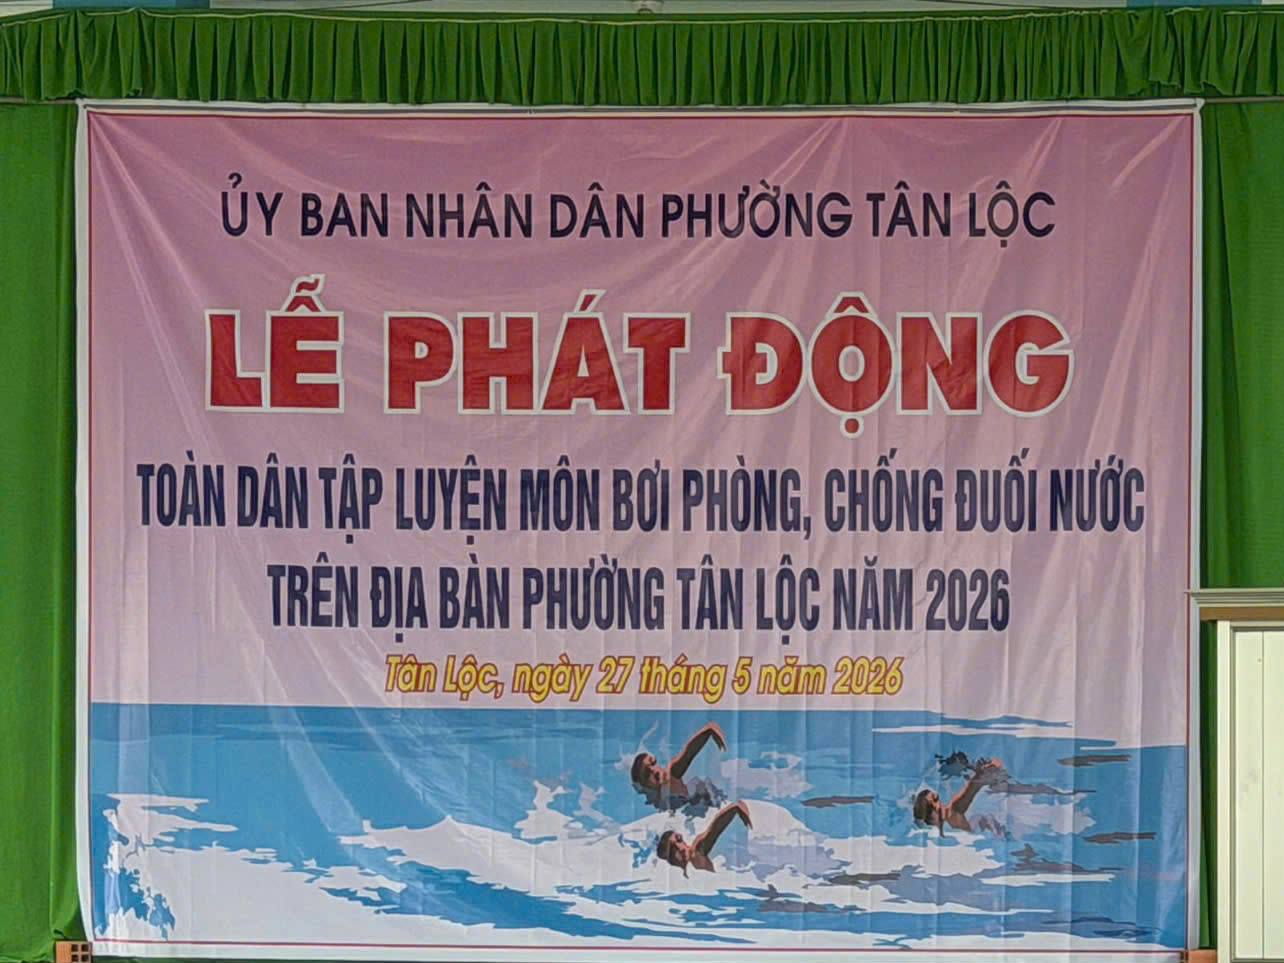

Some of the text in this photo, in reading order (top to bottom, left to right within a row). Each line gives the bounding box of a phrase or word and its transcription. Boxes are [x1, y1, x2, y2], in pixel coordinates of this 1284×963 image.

[221, 172, 1056, 248] ỦY BAN NHÂN DÂN PHƯỜNG TÂN LỘC
[206, 274, 1072, 436] LỄ PHÁT ĐỘNG
[136, 447, 1145, 545] TOÀN DÂN TẬP LUYỆN MÔN BƠI PHÒNG, CHỐNG ĐUỐI NƯỚC
[267, 551, 1010, 645] TRÊN ĐỊA BÀN PHƯỜNG TÂN LỘC NĂM 2026
[384, 652, 905, 704] Tân Lộc, ngày 27 tháng 5 năm 2026
